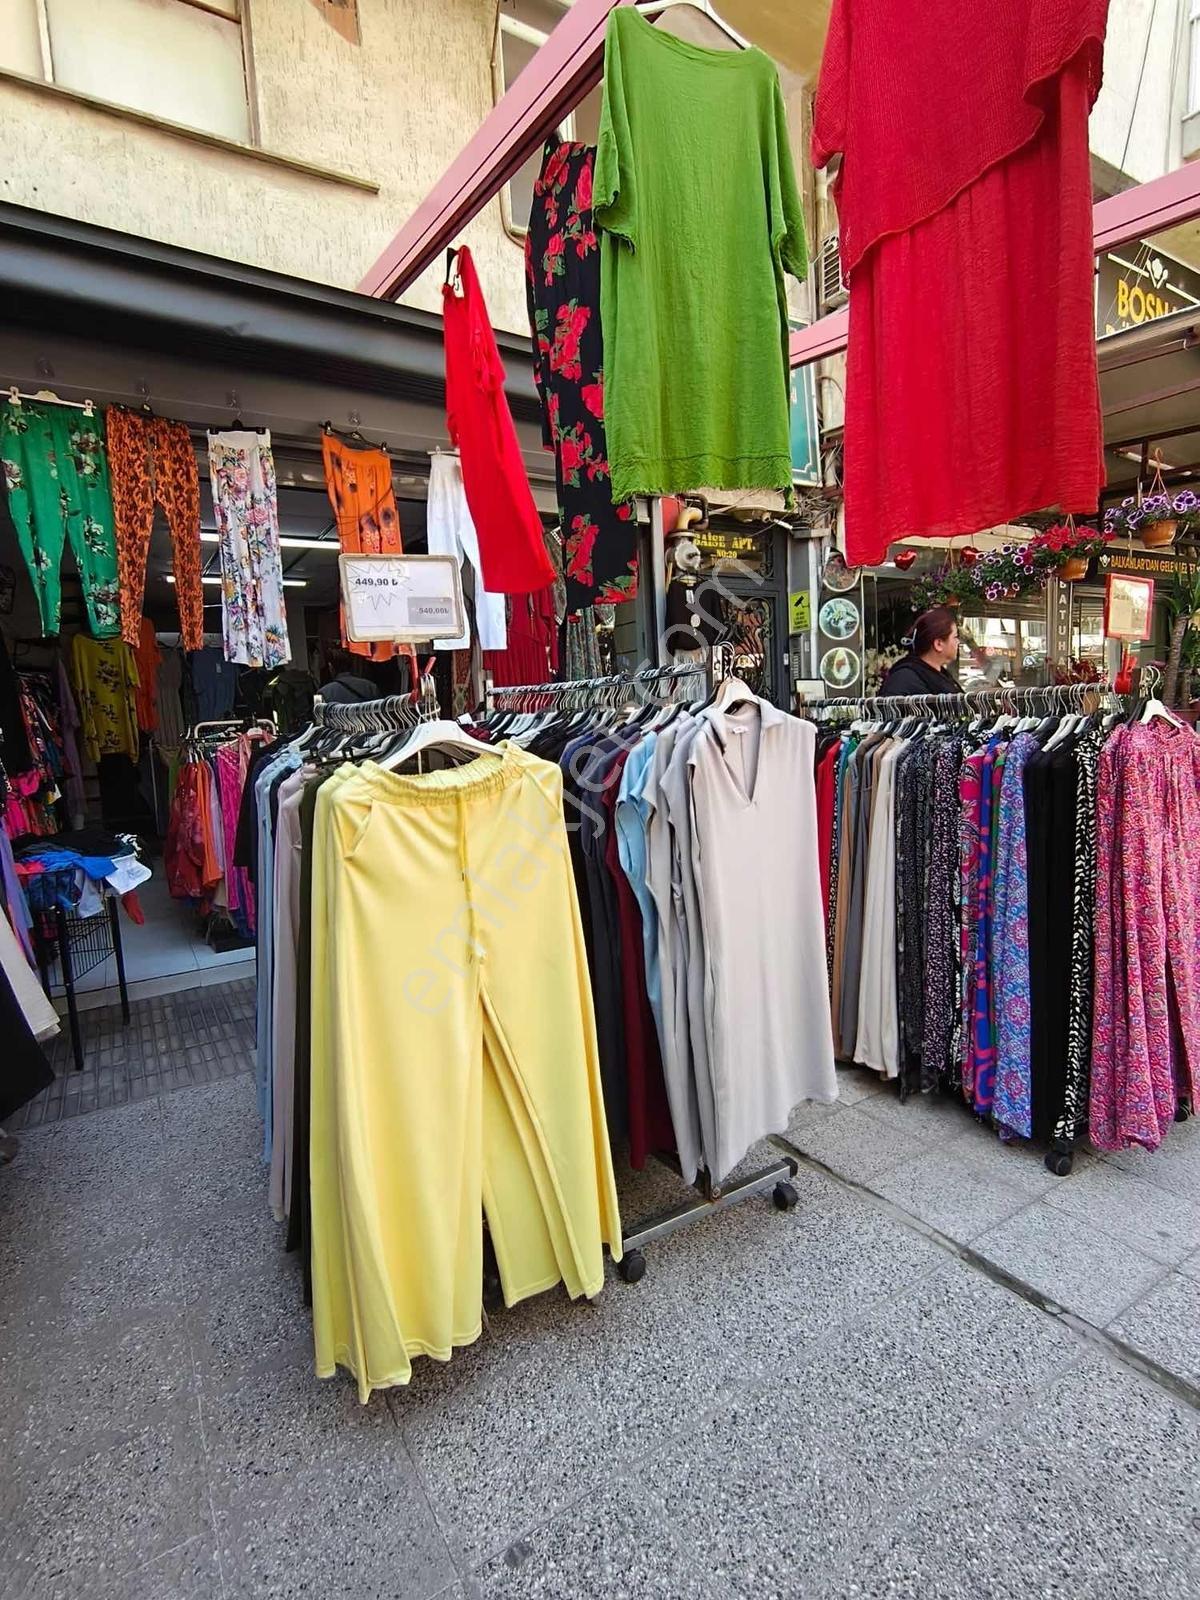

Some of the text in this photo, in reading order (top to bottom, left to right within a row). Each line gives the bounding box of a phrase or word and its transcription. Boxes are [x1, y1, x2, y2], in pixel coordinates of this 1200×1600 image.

[1118, 279, 1178, 324] BOSN
[731, 536, 756, 550] APT.
[355, 578, 389, 586] 449,90
